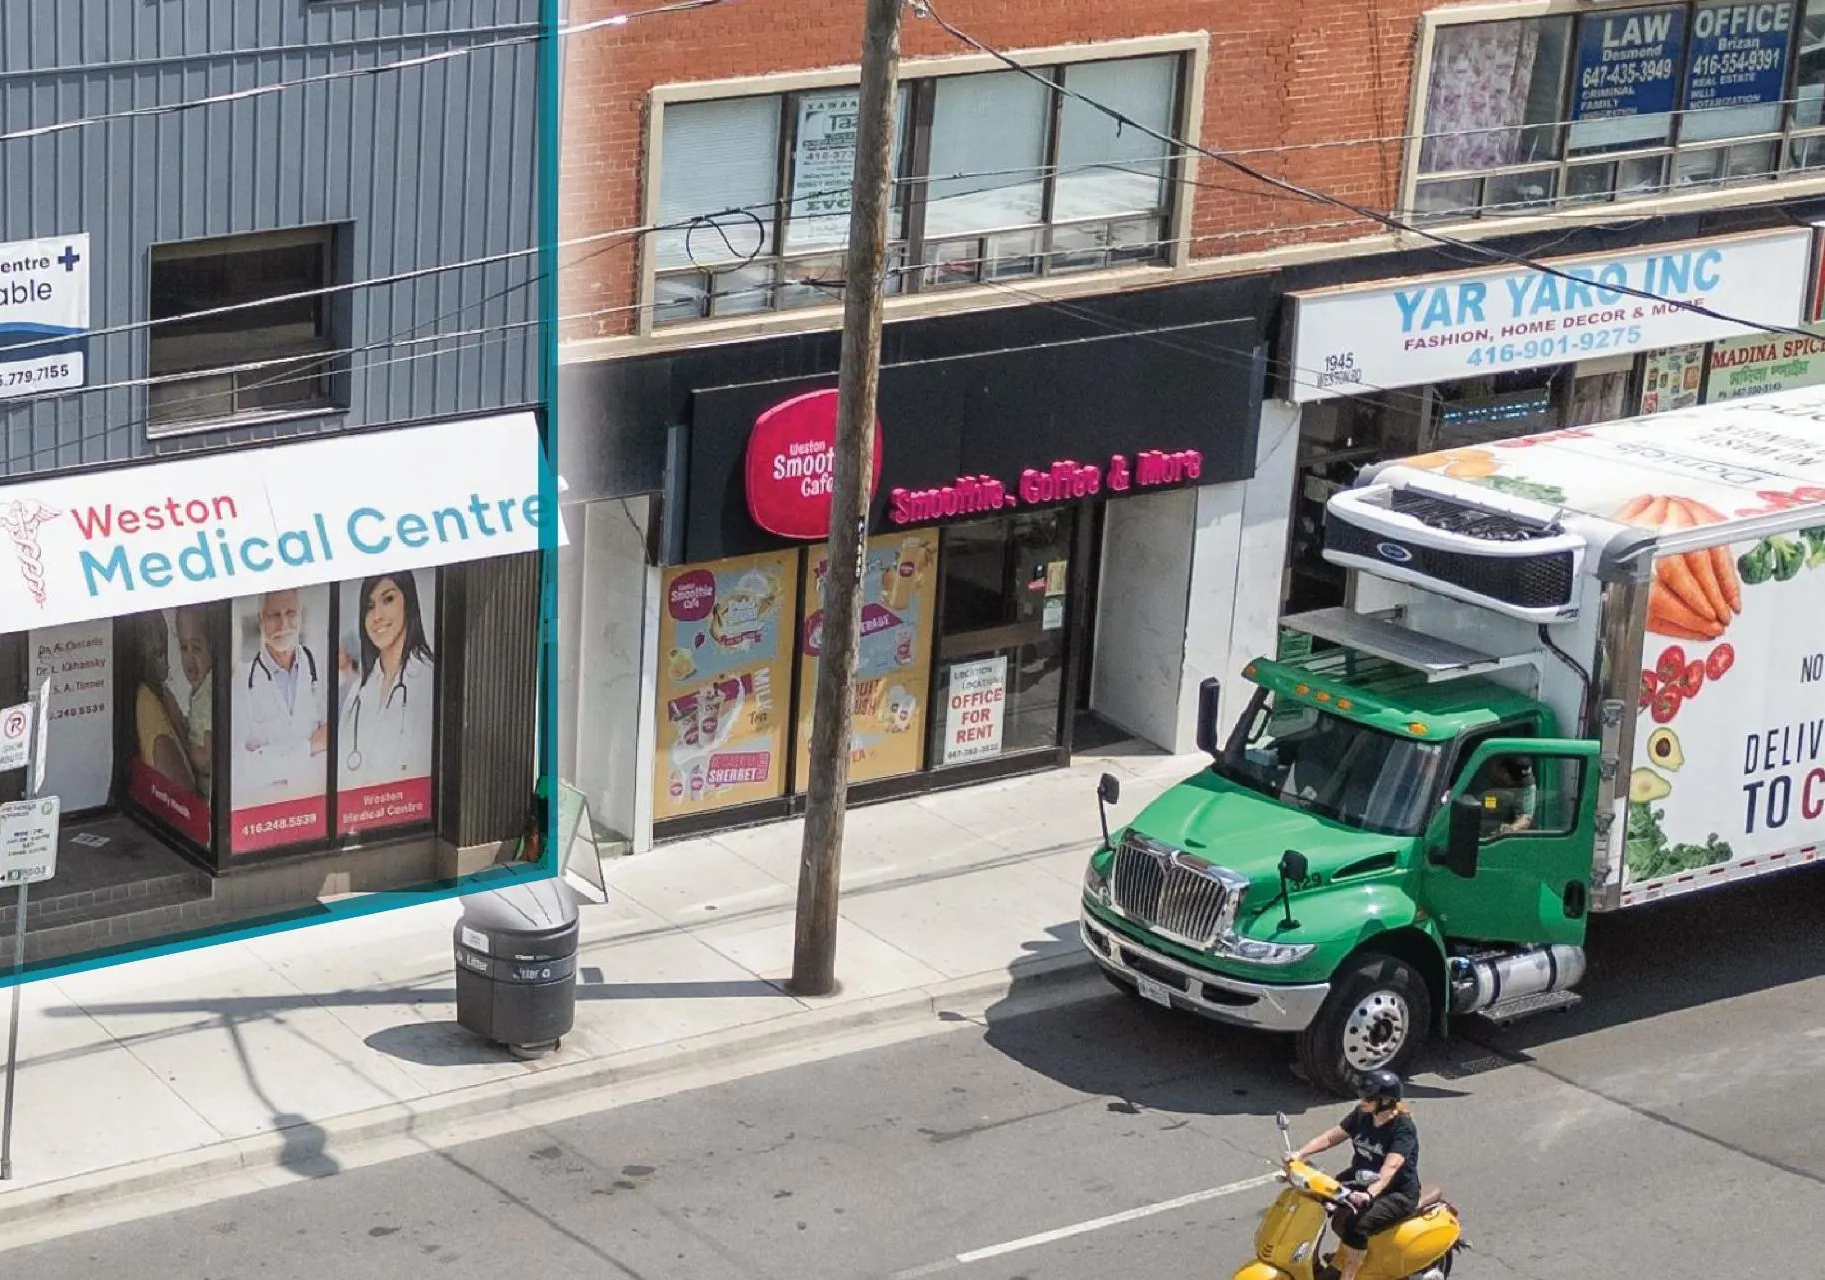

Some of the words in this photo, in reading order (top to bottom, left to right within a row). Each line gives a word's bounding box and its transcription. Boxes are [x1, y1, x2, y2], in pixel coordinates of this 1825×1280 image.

[1603, 12, 1672, 48] LAW
[1695, 2, 1791, 39] OFFICE
[1602, 44, 1662, 62] Desmond
[1394, 281, 1488, 334] YAR
[1504, 261, 1628, 318] YARO
[1643, 249, 1723, 297] INC
[1404, 327, 1495, 352] FASHION,
[1501, 319, 1557, 338] HOME
[1562, 308, 1626, 330] DECOR
[1632, 305, 1644, 320] &
[1325, 352, 1355, 372] 1945
[1466, 325, 1643, 368] 416-901-9275
[1711, 343, 1778, 370] MADINA
[773, 447, 836, 481] Smoot
[789, 440, 826, 455] Weston
[1107, 453, 1131, 491] &
[71, 494, 238, 540] Weston
[79, 512, 331, 598] Medical
[346, 492, 550, 555] Centre
[1799, 653, 1825, 683] NO
[951, 688, 1003, 710] OFFICE
[955, 724, 994, 744] RENT
[961, 708, 991, 726] FOR
[1743, 775, 1792, 835] TO
